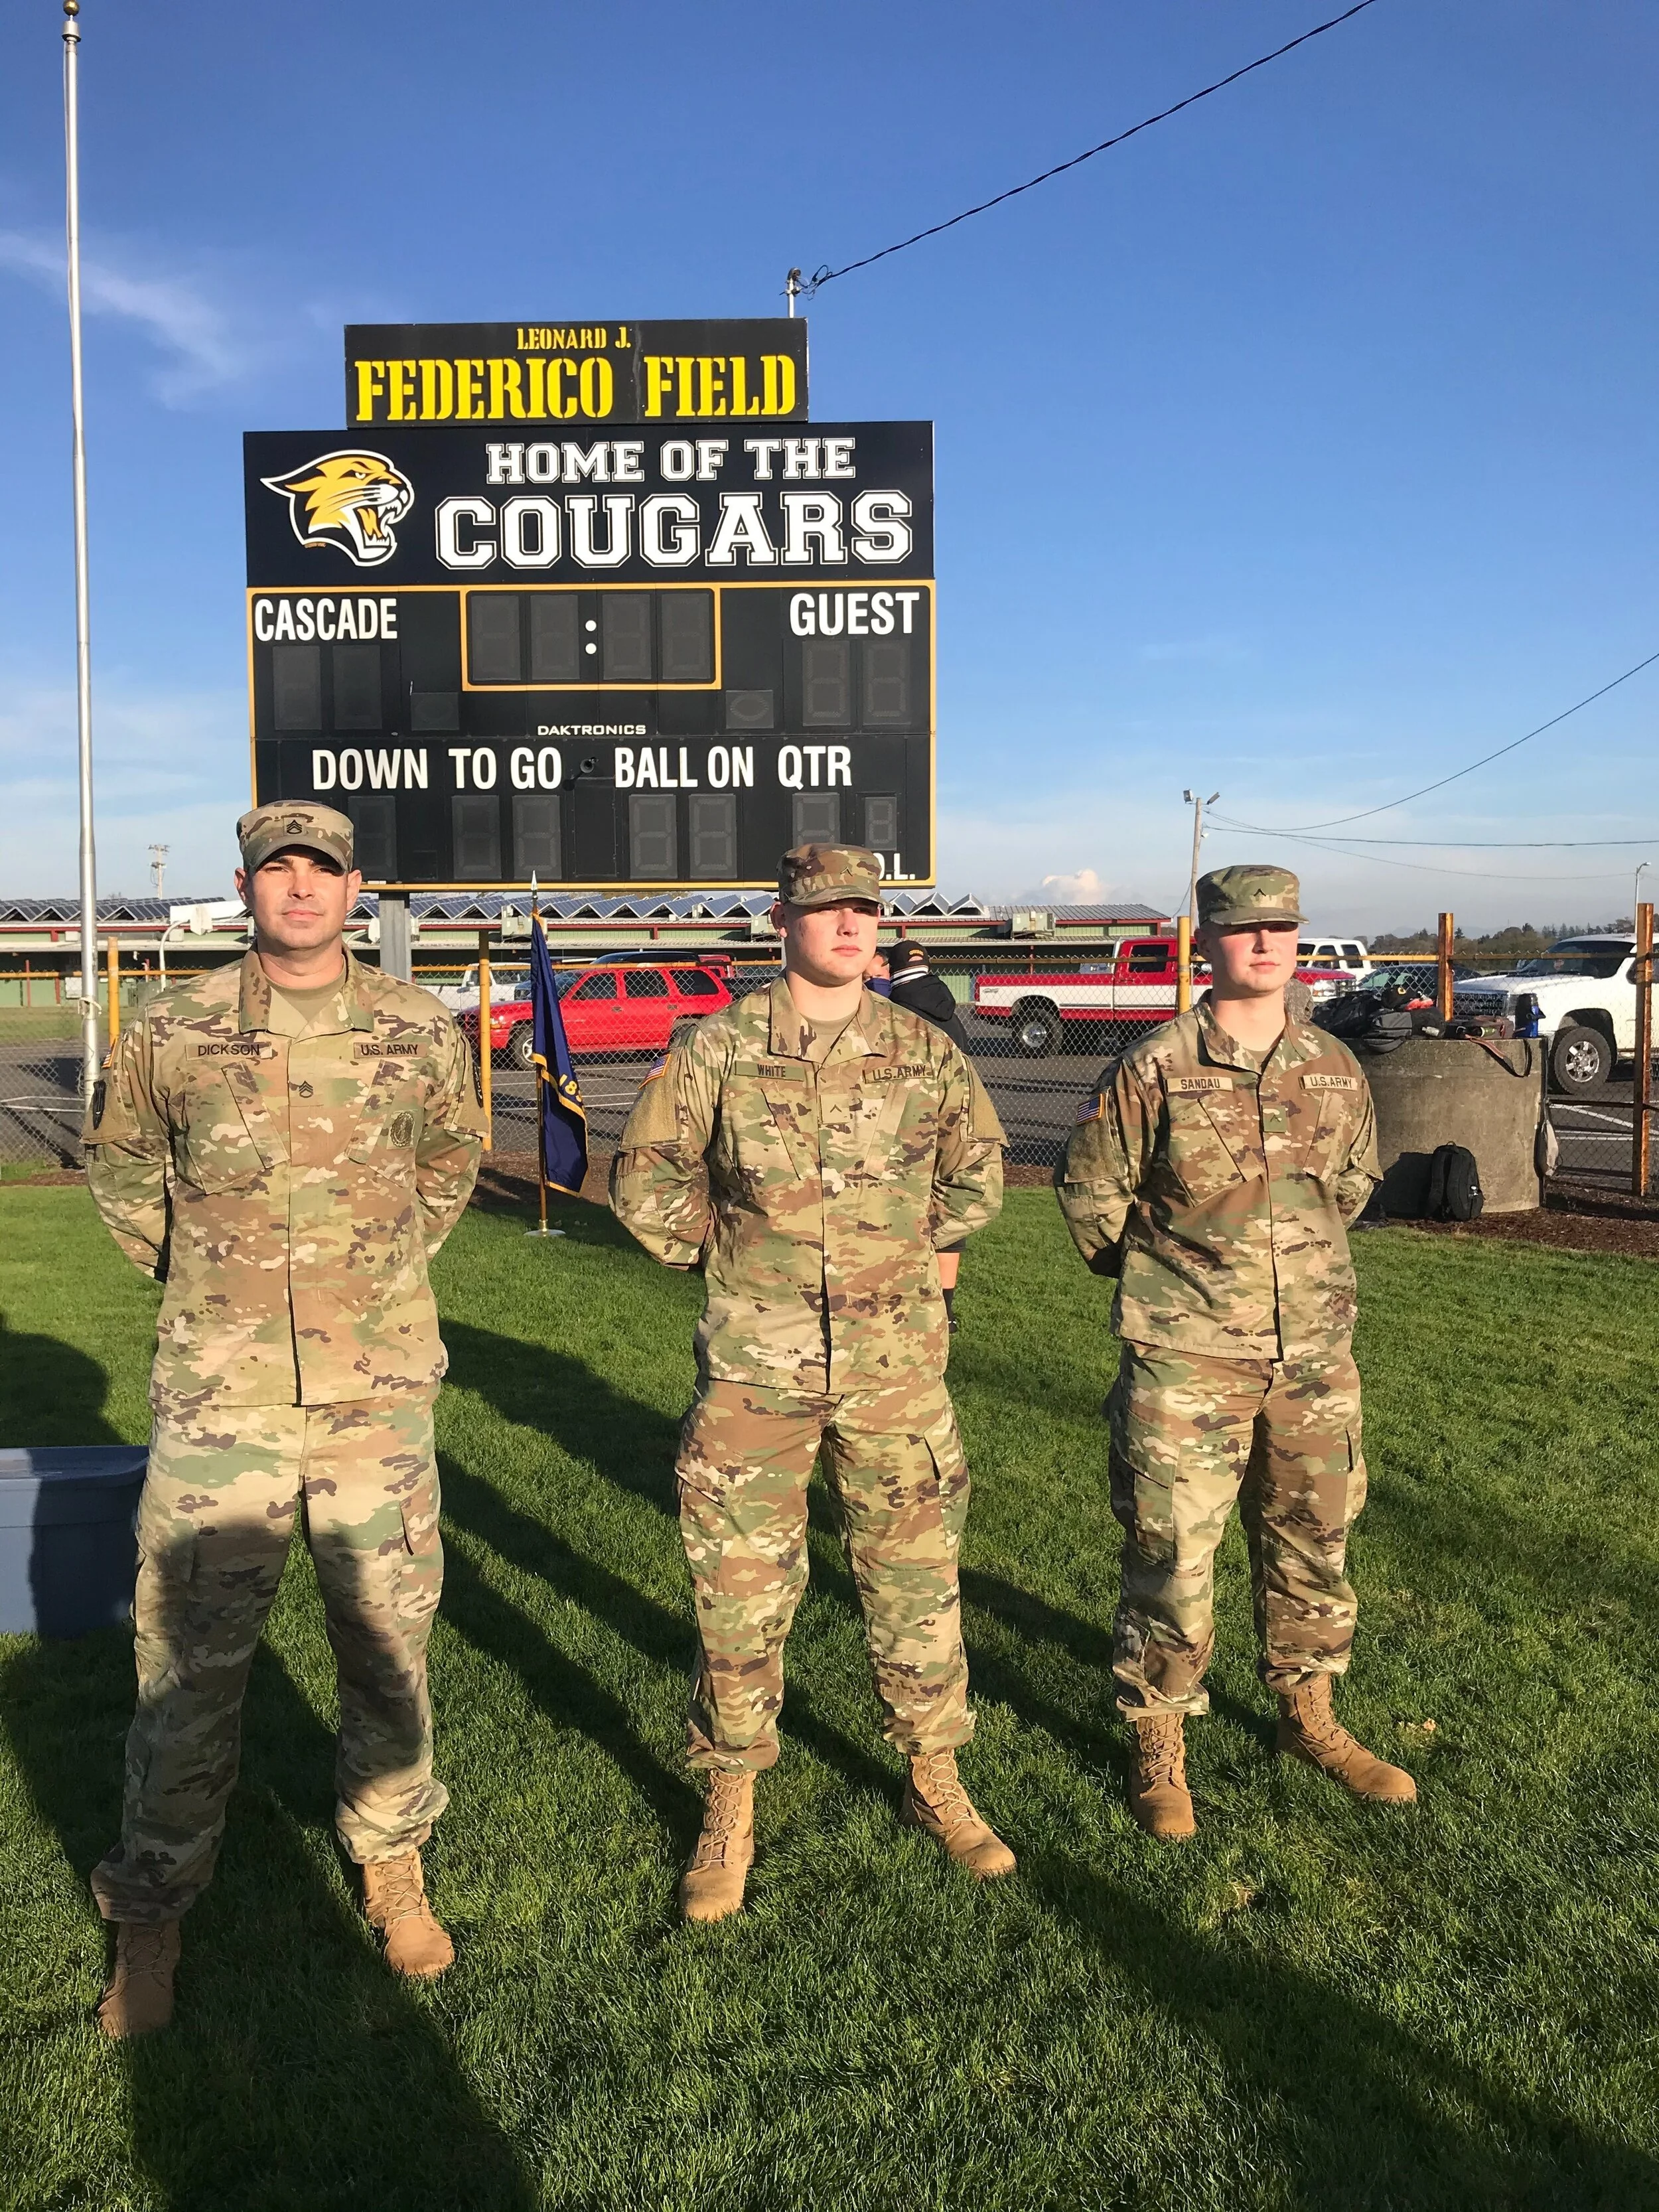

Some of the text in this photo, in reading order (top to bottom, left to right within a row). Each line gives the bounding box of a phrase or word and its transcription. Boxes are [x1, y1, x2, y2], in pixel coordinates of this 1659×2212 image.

[516, 327, 631, 350] LEONARD J.
[354, 354, 796, 421] FEDERICO FIELD
[485, 437, 856, 484] HOME OF THE
[435, 489, 913, 571] COUGARS
[255, 598, 397, 642] CASCADE
[790, 591, 920, 636] GUEST
[538, 725, 646, 736] DAKTRONICS
[312, 748, 428, 790] DOWN
[448, 747, 562, 790] TO GO
[614, 745, 754, 788] BALL ON
[778, 745, 853, 790] QTR
[198, 1044, 259, 1057] DICKSON
[361, 1044, 418, 1055] U.S. ARMY
[757, 1064, 786, 1077] WHITE
[1181, 1078, 1220, 1090] SANDAU
